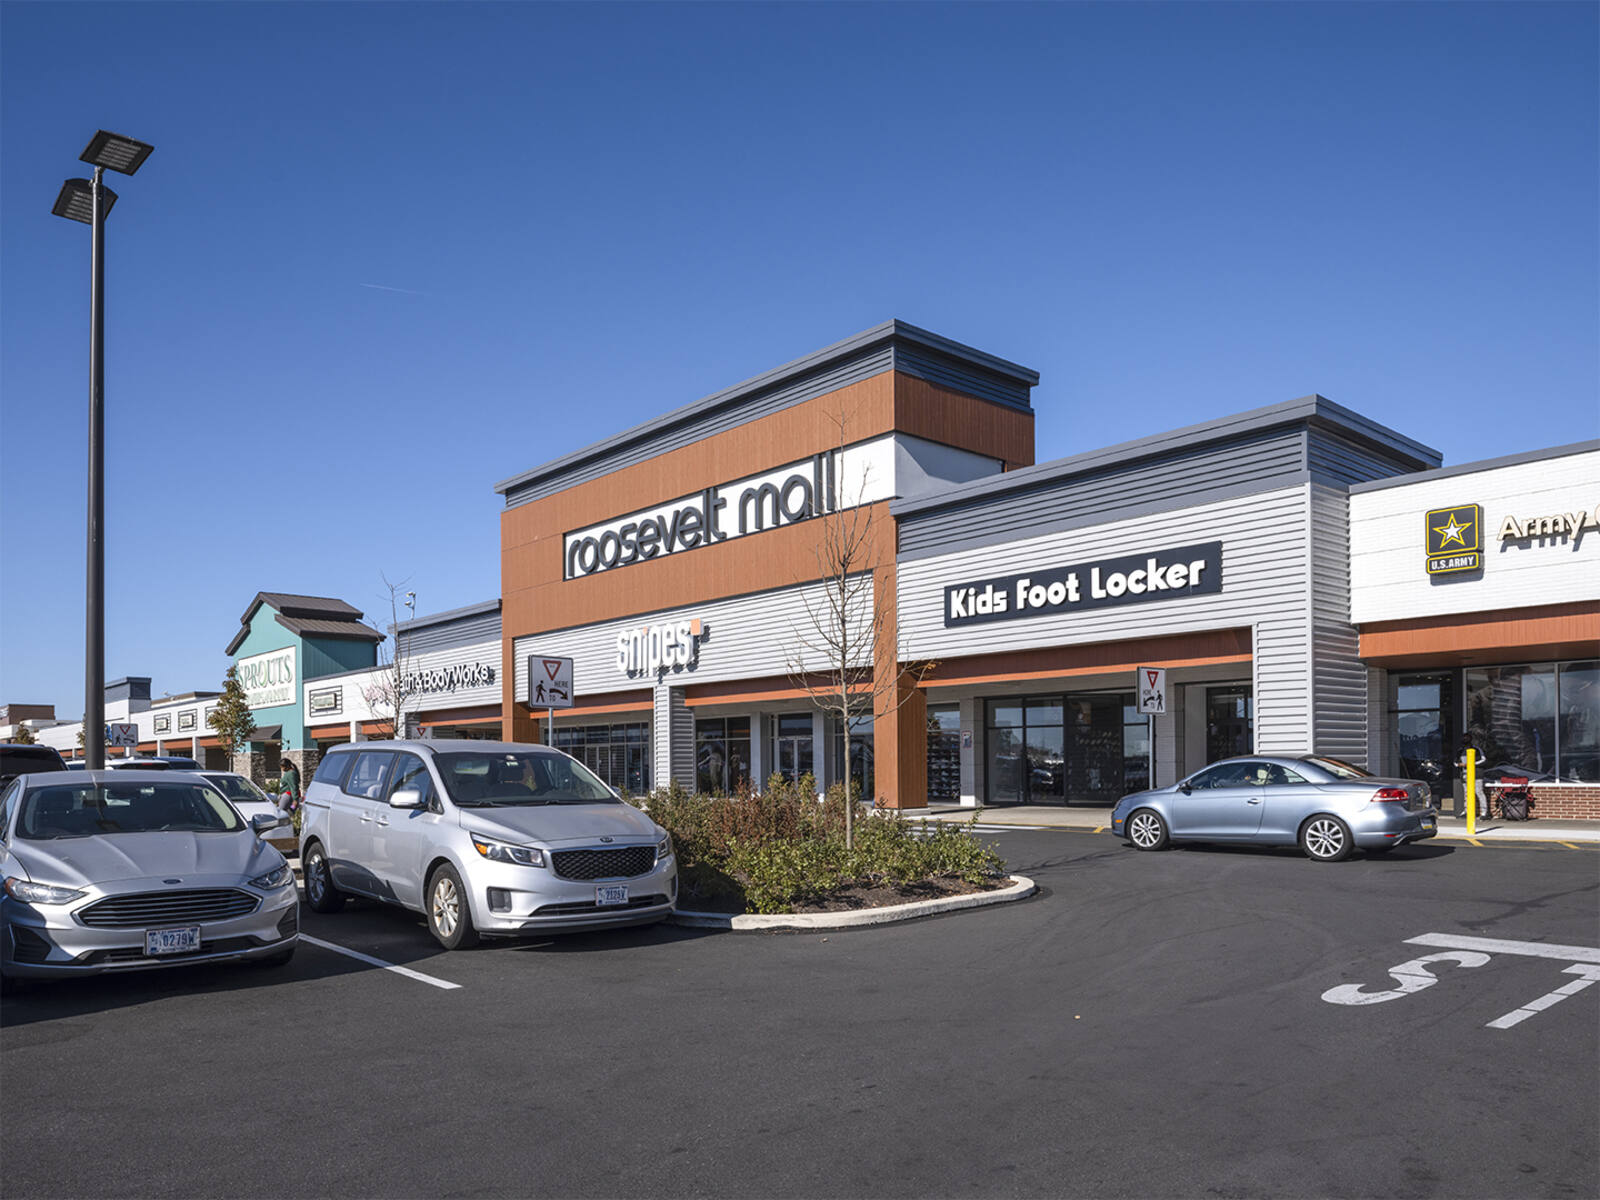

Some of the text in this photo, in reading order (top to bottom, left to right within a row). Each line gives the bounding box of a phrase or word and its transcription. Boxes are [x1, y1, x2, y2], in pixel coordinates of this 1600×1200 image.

[568, 450, 836, 577] roosevelt mall
[1498, 511, 1586, 540] Army
[951, 558, 1206, 619] Kids Foot Locker
[239, 655, 293, 690] SPROUTS
[617, 619, 692, 677] snipes
